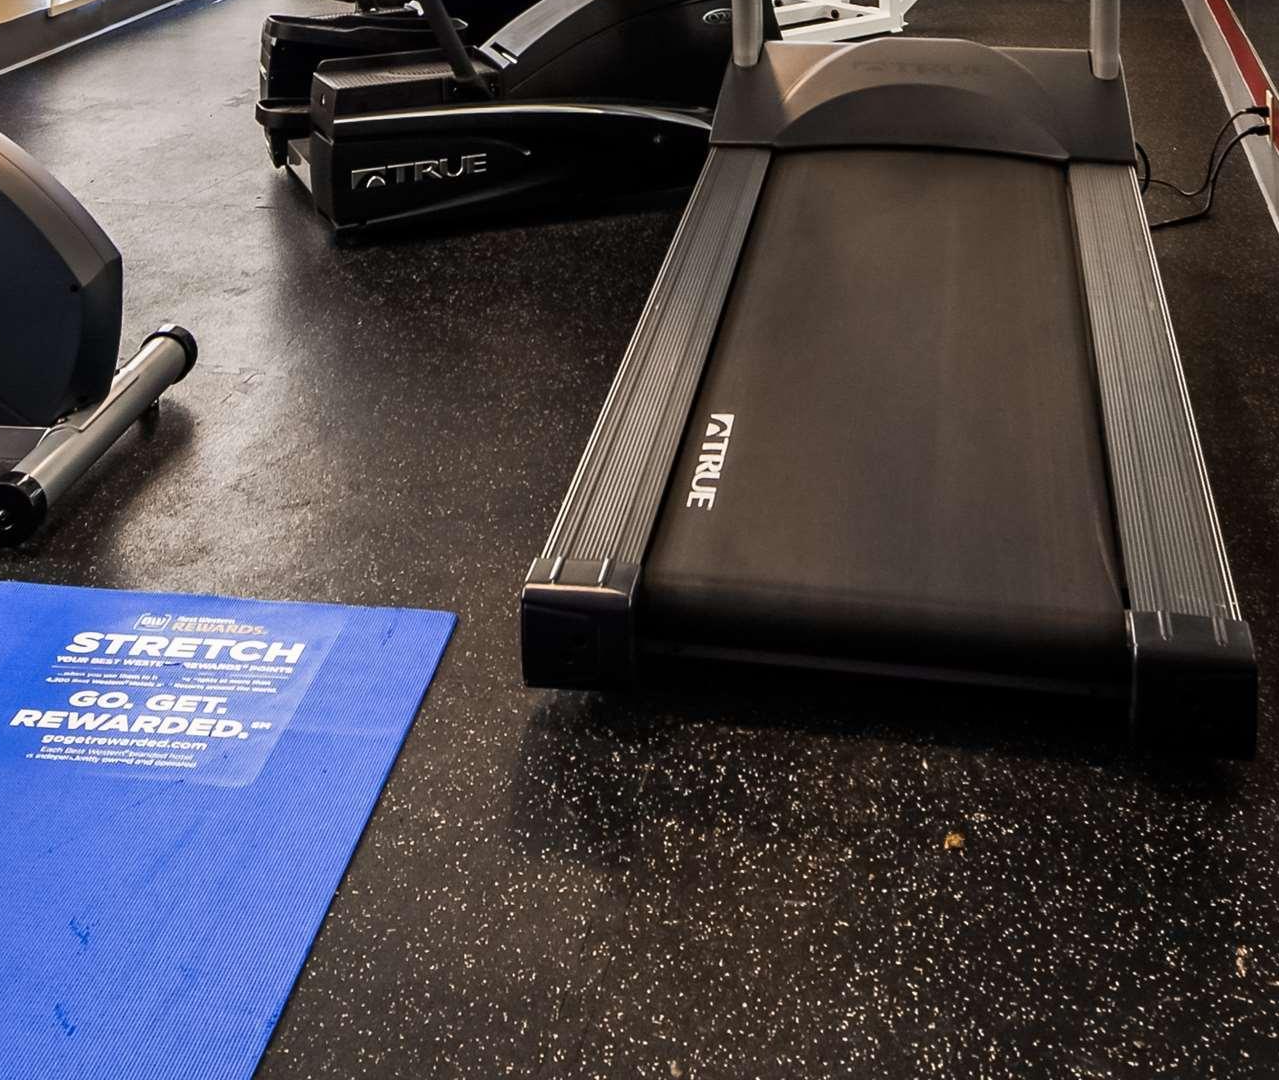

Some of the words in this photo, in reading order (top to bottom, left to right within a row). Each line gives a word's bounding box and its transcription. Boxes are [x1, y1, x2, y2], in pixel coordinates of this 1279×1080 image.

[387, 153, 488, 184] TRUE
[686, 437, 730, 512] TRUE
[65, 632, 306, 663] STRETCH
[57, 655, 89, 664] YOUR
[90, 657, 121, 665] BEST
[249, 665, 293, 674] POINTS
[69, 690, 134, 709] GO.
[145, 694, 228, 715] GET.
[41, 733, 209, 751] gogetrewarded.com
